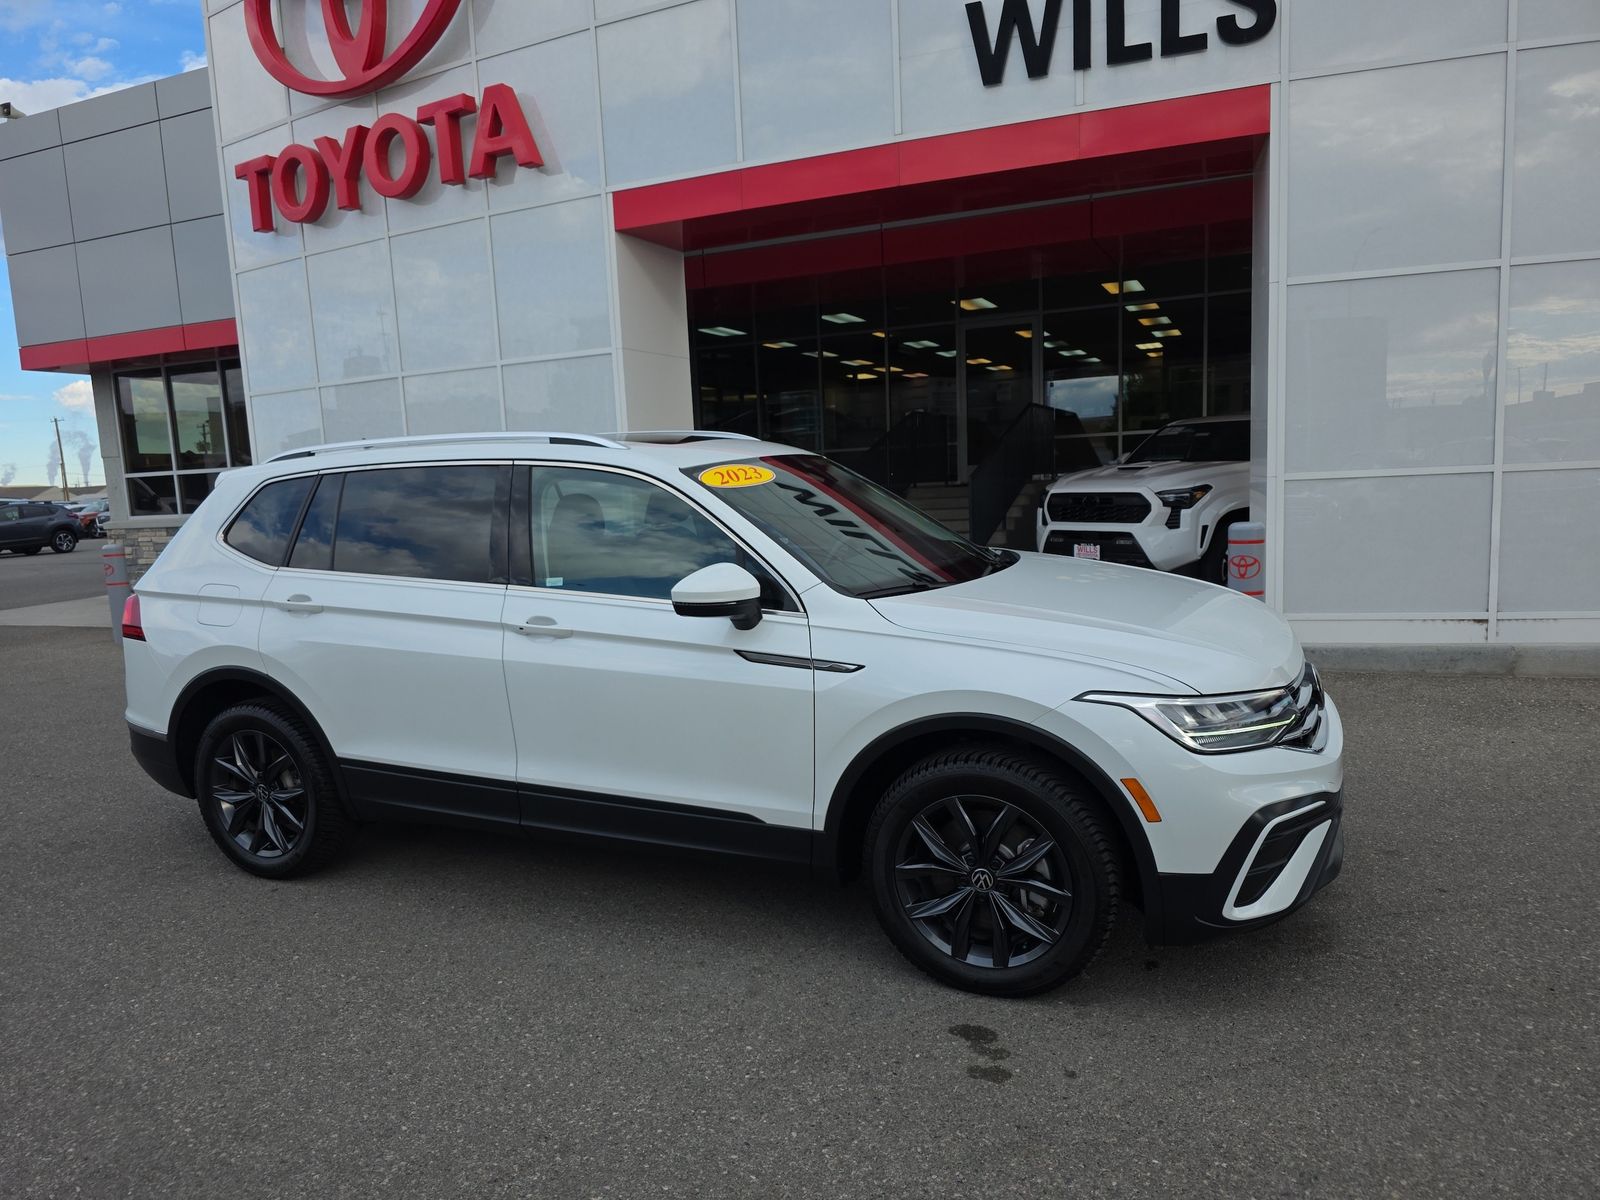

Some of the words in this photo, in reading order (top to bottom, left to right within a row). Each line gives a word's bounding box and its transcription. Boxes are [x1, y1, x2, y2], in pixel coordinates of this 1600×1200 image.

[965, 0, 1277, 87] WILLS
[234, 83, 545, 233] TOYOTA
[713, 467, 763, 486] 2023
[1076, 545, 1098, 554] WILLS
